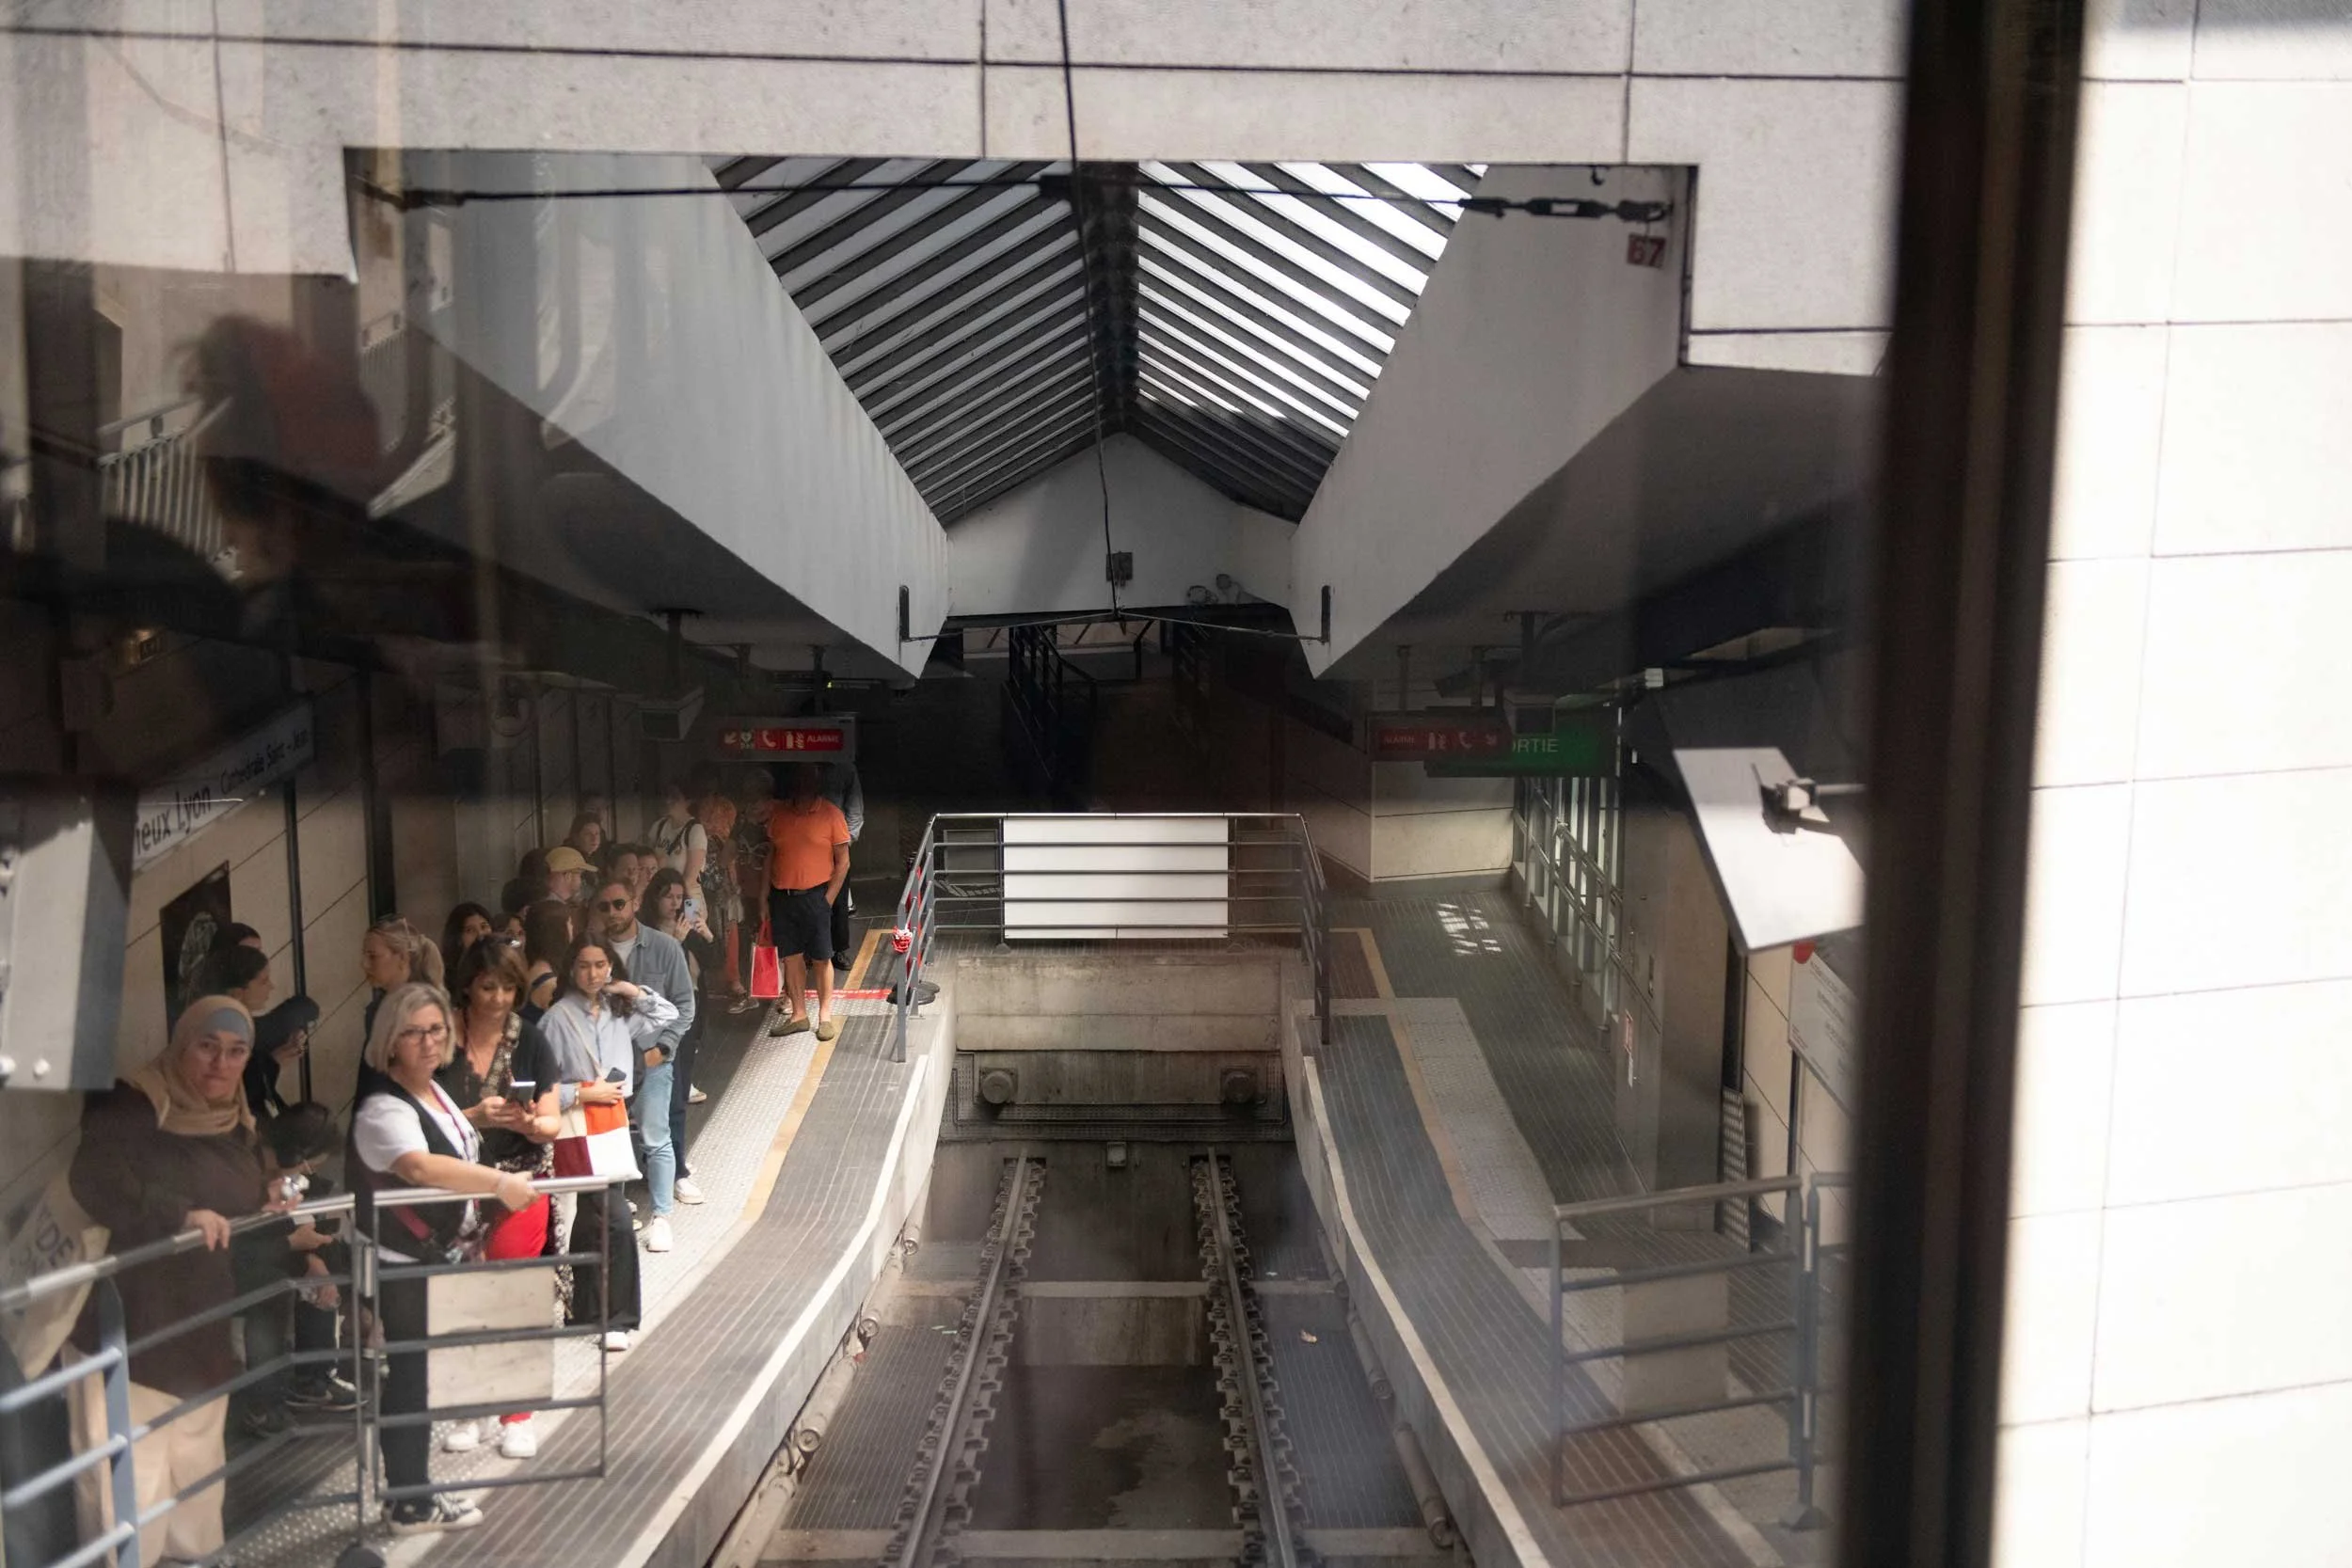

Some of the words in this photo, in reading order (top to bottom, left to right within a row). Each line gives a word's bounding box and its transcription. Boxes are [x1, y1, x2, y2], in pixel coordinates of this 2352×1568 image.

[806, 735, 840, 743] ALARME
[1512, 738, 1560, 753] RTIE
[135, 808, 171, 856] ieux
[175, 785, 212, 835] Lyon
